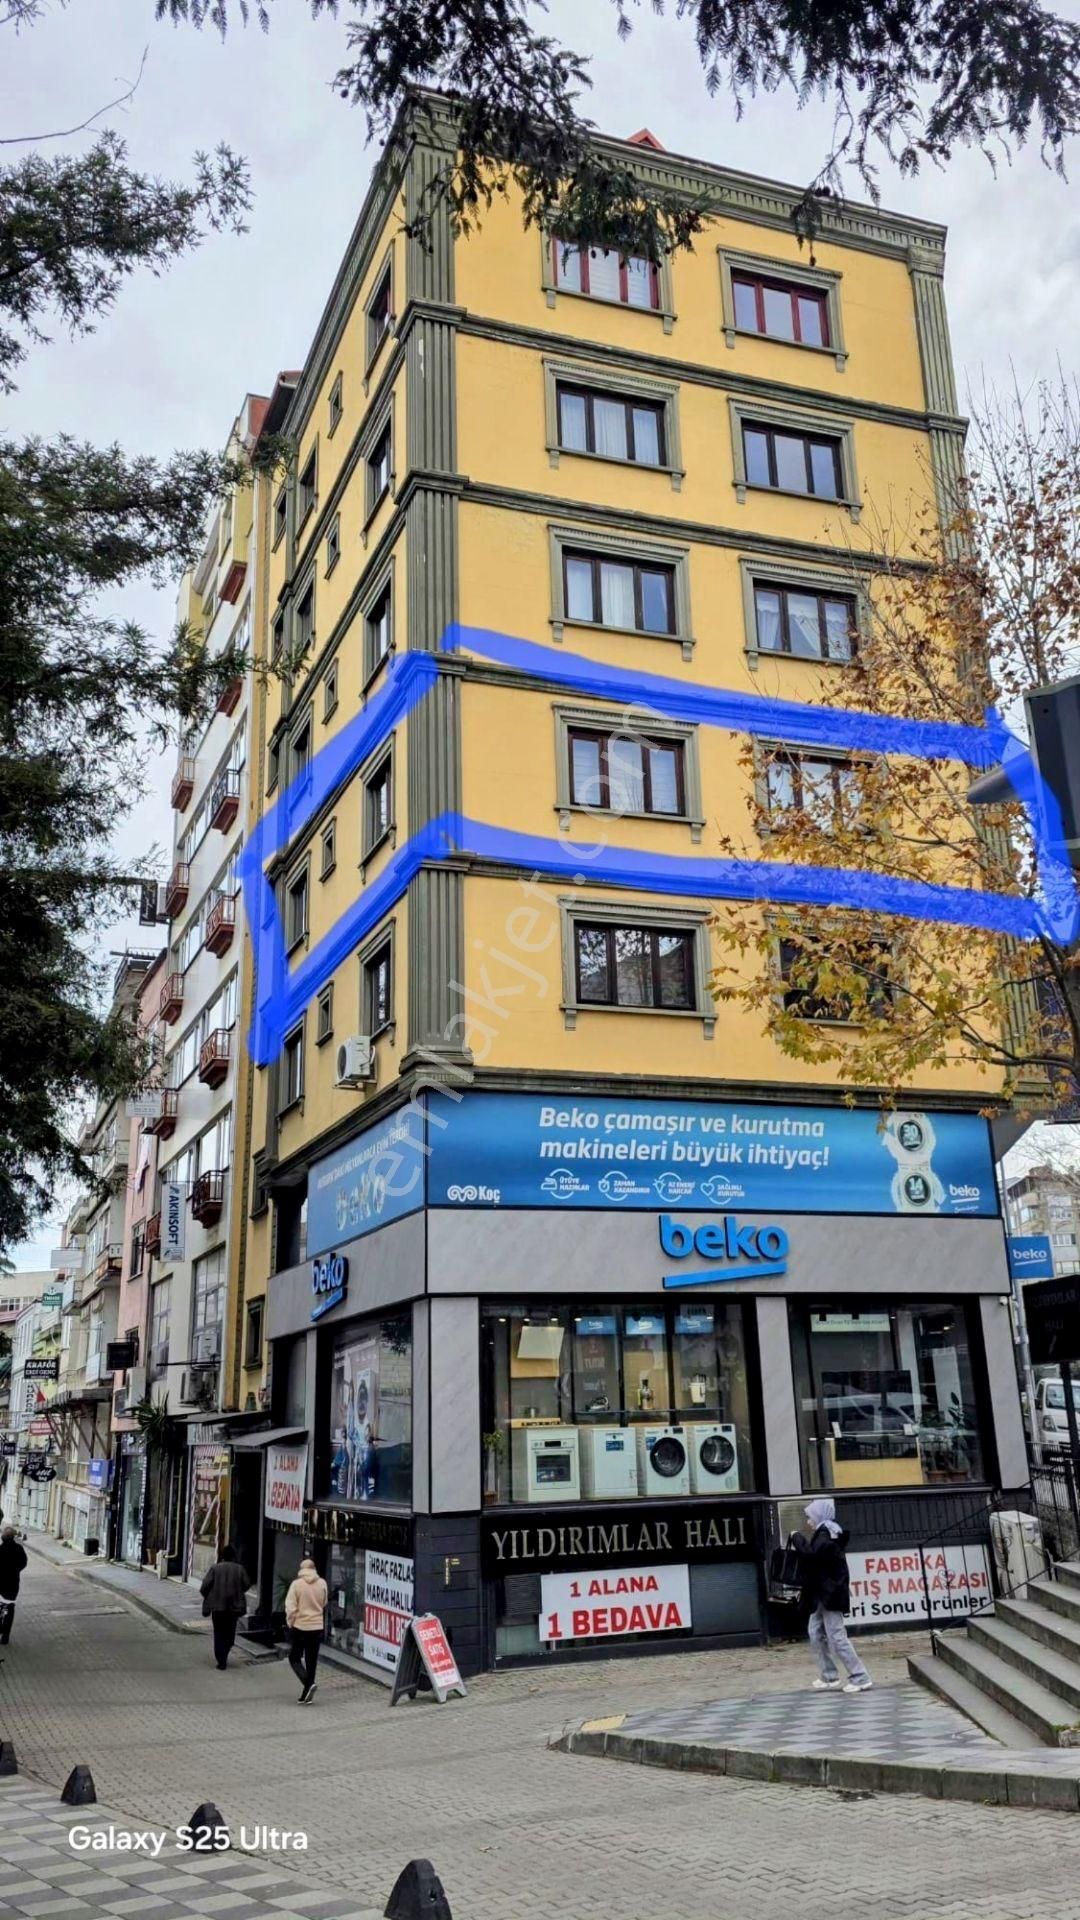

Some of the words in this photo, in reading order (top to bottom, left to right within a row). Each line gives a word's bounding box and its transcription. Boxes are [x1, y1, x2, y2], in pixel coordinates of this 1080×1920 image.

[539, 1107, 599, 1129] Beko
[604, 1110, 696, 1136] çamaşır
[700, 1116, 726, 1134] ve
[731, 1114, 825, 1137] kurutma
[539, 1138, 668, 1162] makineleri
[671, 1141, 743, 1167] büyük
[748, 1144, 830, 1170] ihtiyaç!
[478, 1186, 500, 1203] Koç
[949, 1184, 980, 1197] beko
[168, 1195, 180, 1245] AKINSOFT
[658, 1214, 790, 1260] beko
[1013, 1249, 1047, 1260] beko
[312, 1252, 348, 1295] beko
[271, 1481, 300, 1512] BEDAVA
[491, 1521, 673, 1559] YILDIRIMLAR
[684, 1517, 747, 1547] HALI
[389, 1563, 414, 1584] FAZLAS
[570, 1581, 581, 1597] 1
[588, 1575, 659, 1596] ALANA
[367, 1584, 390, 1606] MARKA
[849, 1580, 881, 1600] TIŞ
[547, 1612, 562, 1638] 1
[573, 1602, 682, 1637] BEDAVA
[872, 1602, 915, 1616] Sonu
